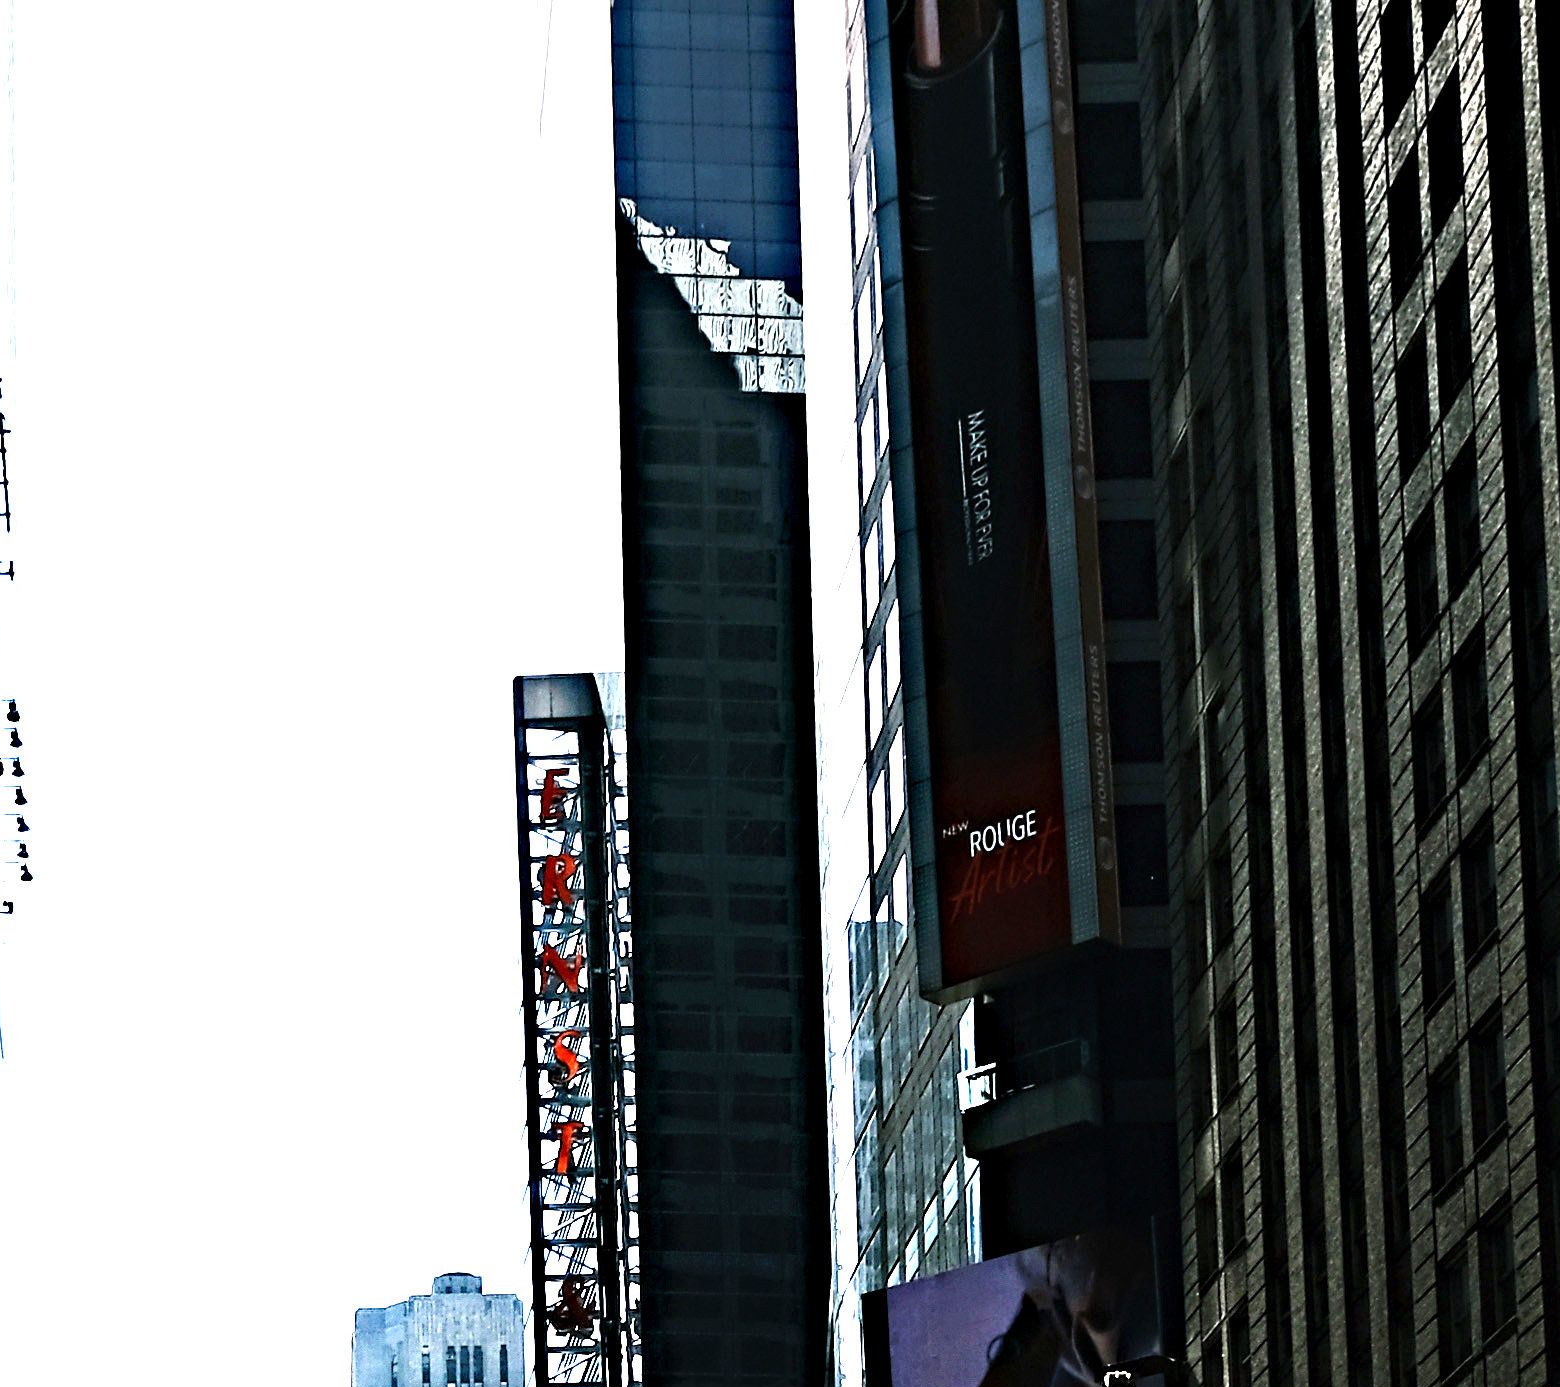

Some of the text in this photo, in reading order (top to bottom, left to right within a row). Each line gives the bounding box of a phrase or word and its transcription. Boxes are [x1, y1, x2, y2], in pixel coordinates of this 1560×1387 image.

[942, 809, 1038, 858] NEW ROUGE
[540, 767, 583, 1176] ERNST
